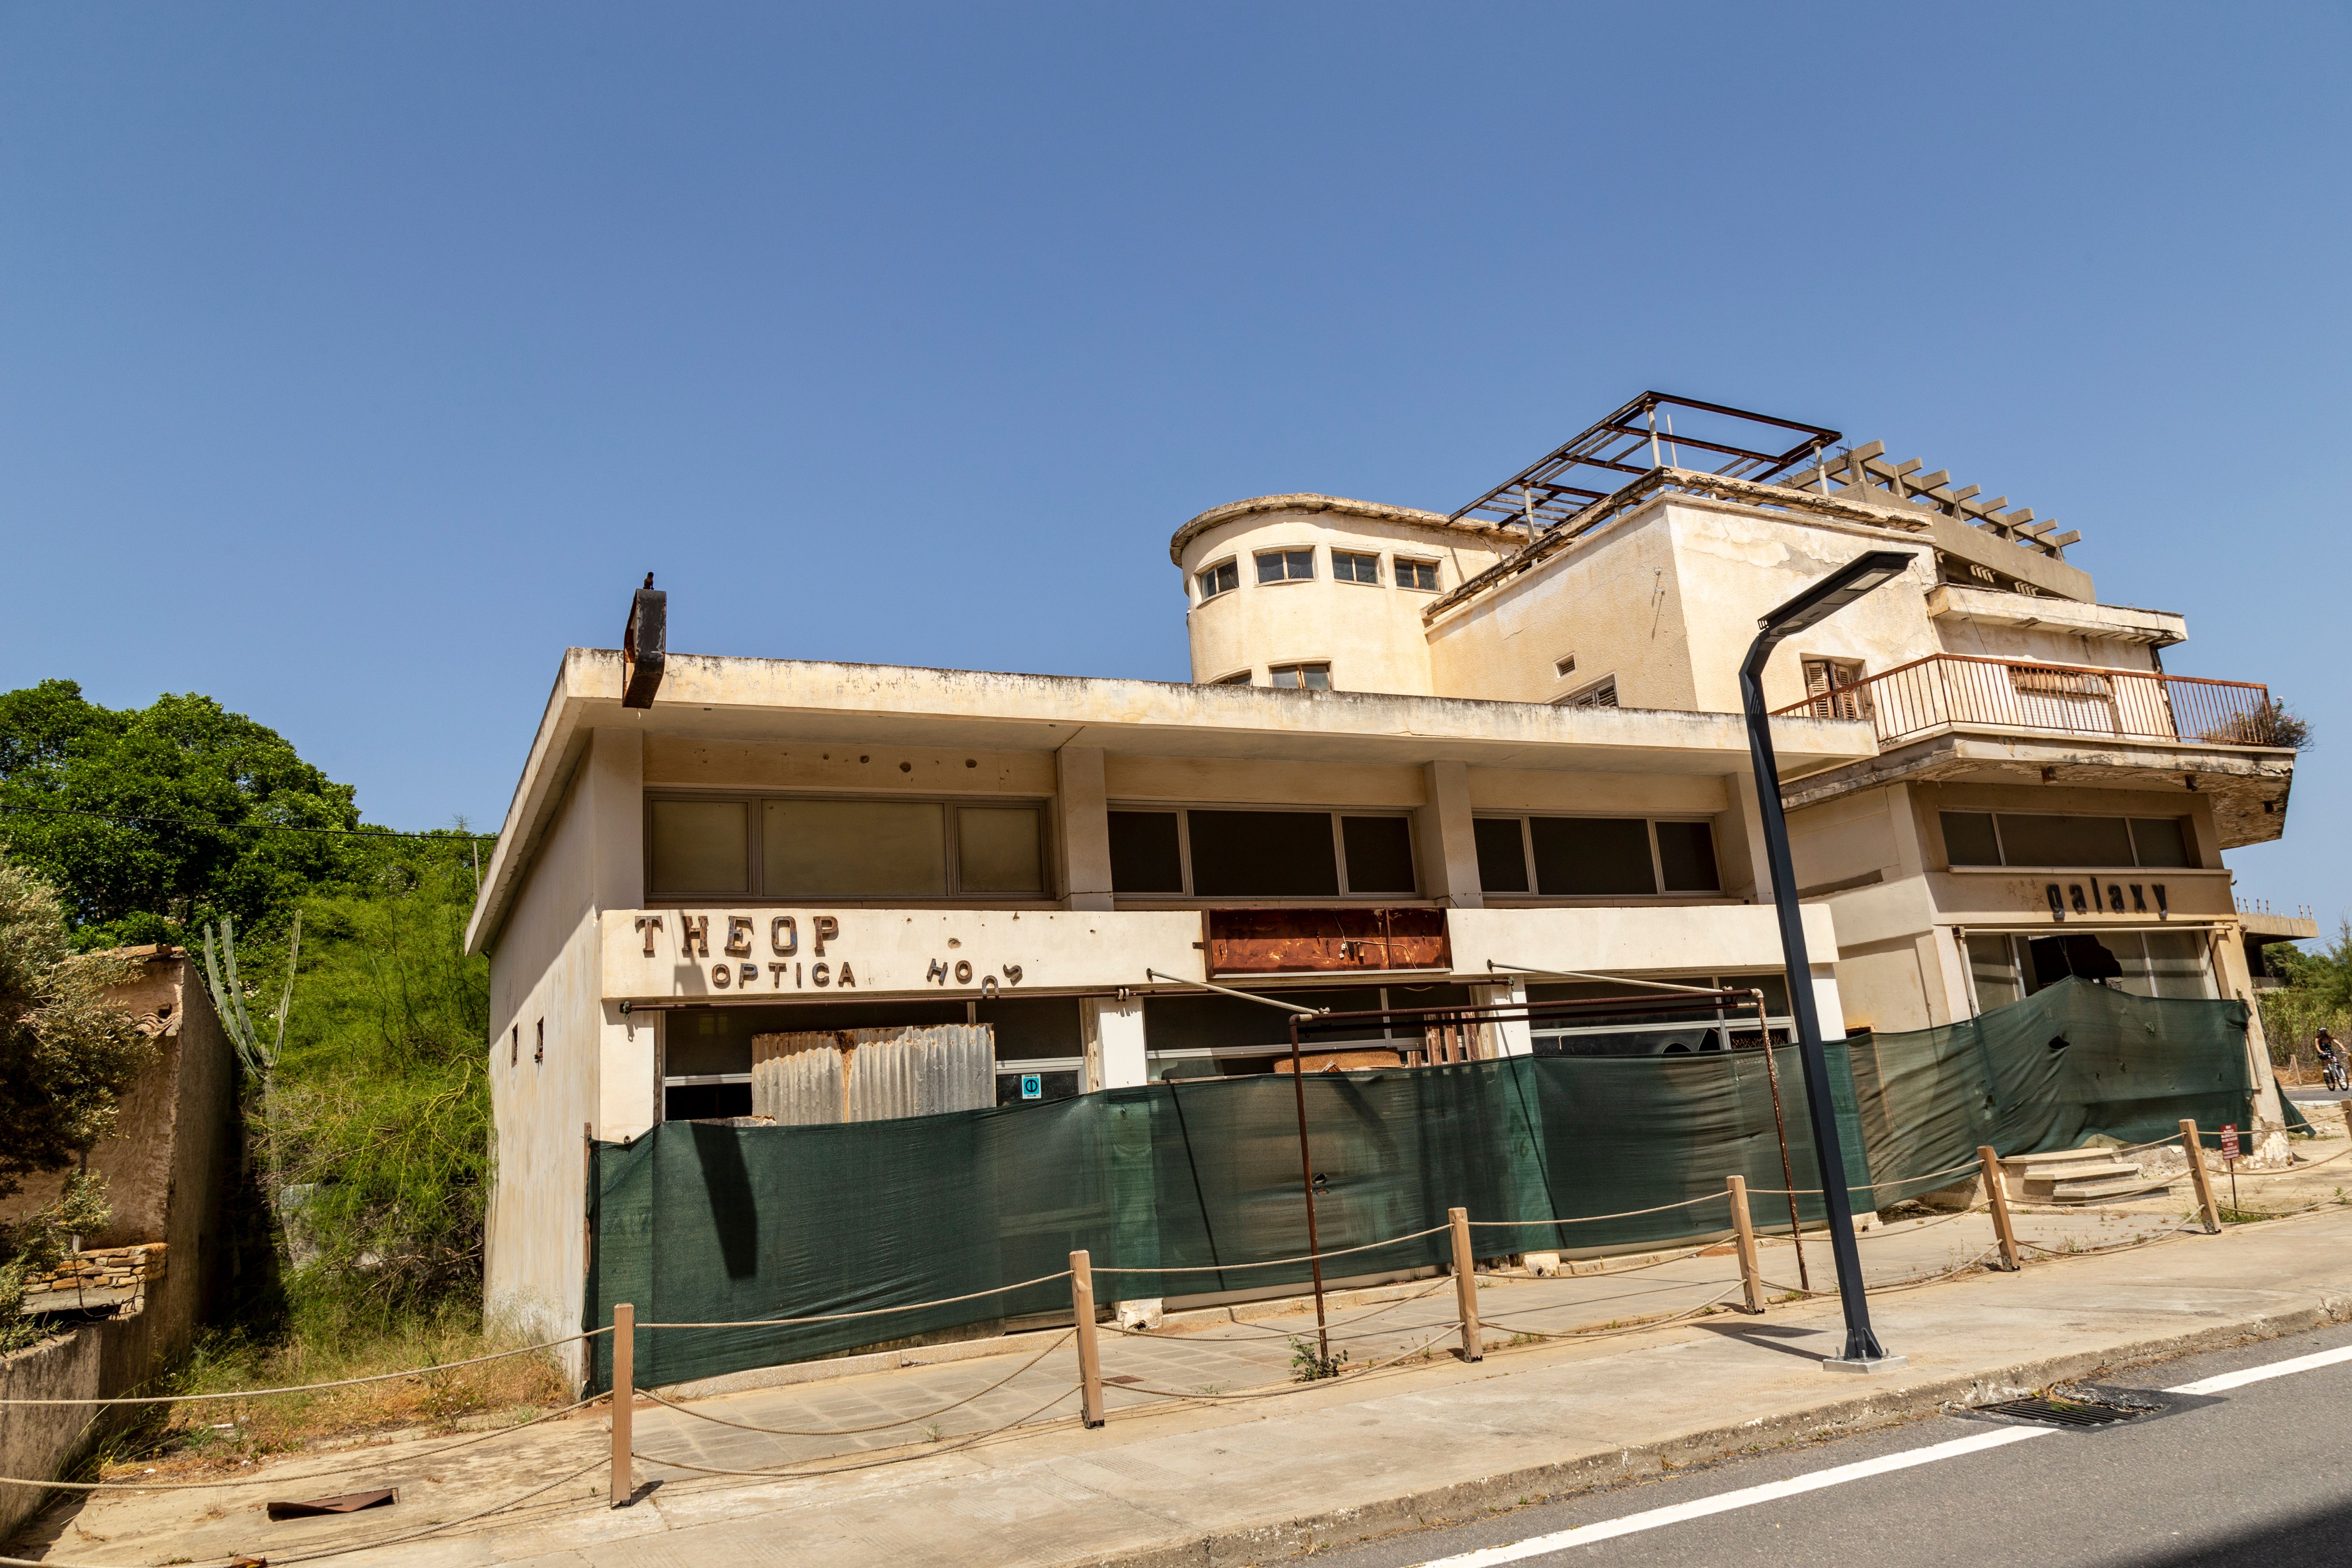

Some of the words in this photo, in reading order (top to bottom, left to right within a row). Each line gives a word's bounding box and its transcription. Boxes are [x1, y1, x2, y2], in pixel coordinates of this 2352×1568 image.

[2046, 876, 2168, 918] galaxy
[634, 916, 839, 951] THEOP
[711, 962, 855, 984] OPTICA
